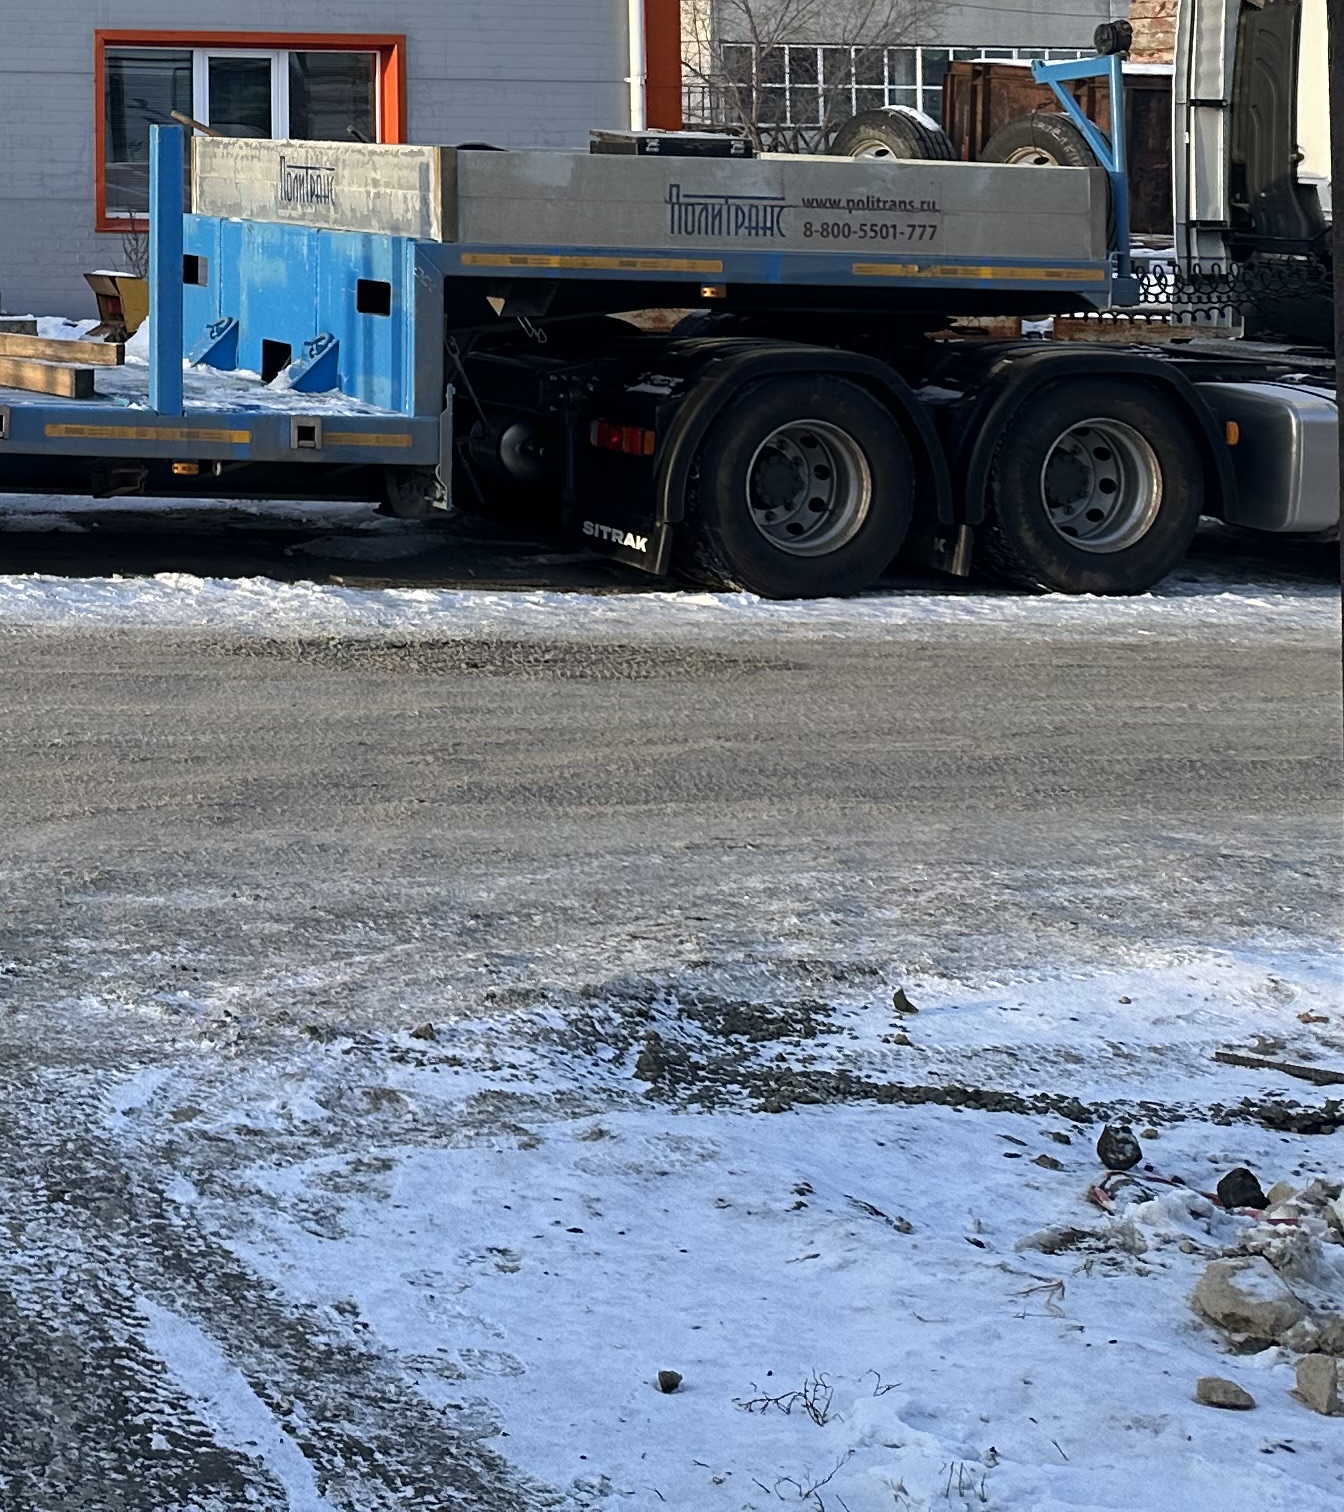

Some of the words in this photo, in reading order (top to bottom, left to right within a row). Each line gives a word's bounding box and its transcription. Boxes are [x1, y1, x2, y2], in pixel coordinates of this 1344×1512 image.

[801, 195, 937, 214] www.politrans.ru
[803, 221, 938, 241] 8-800-5501-777
[582, 520, 648, 553] SITRAK
